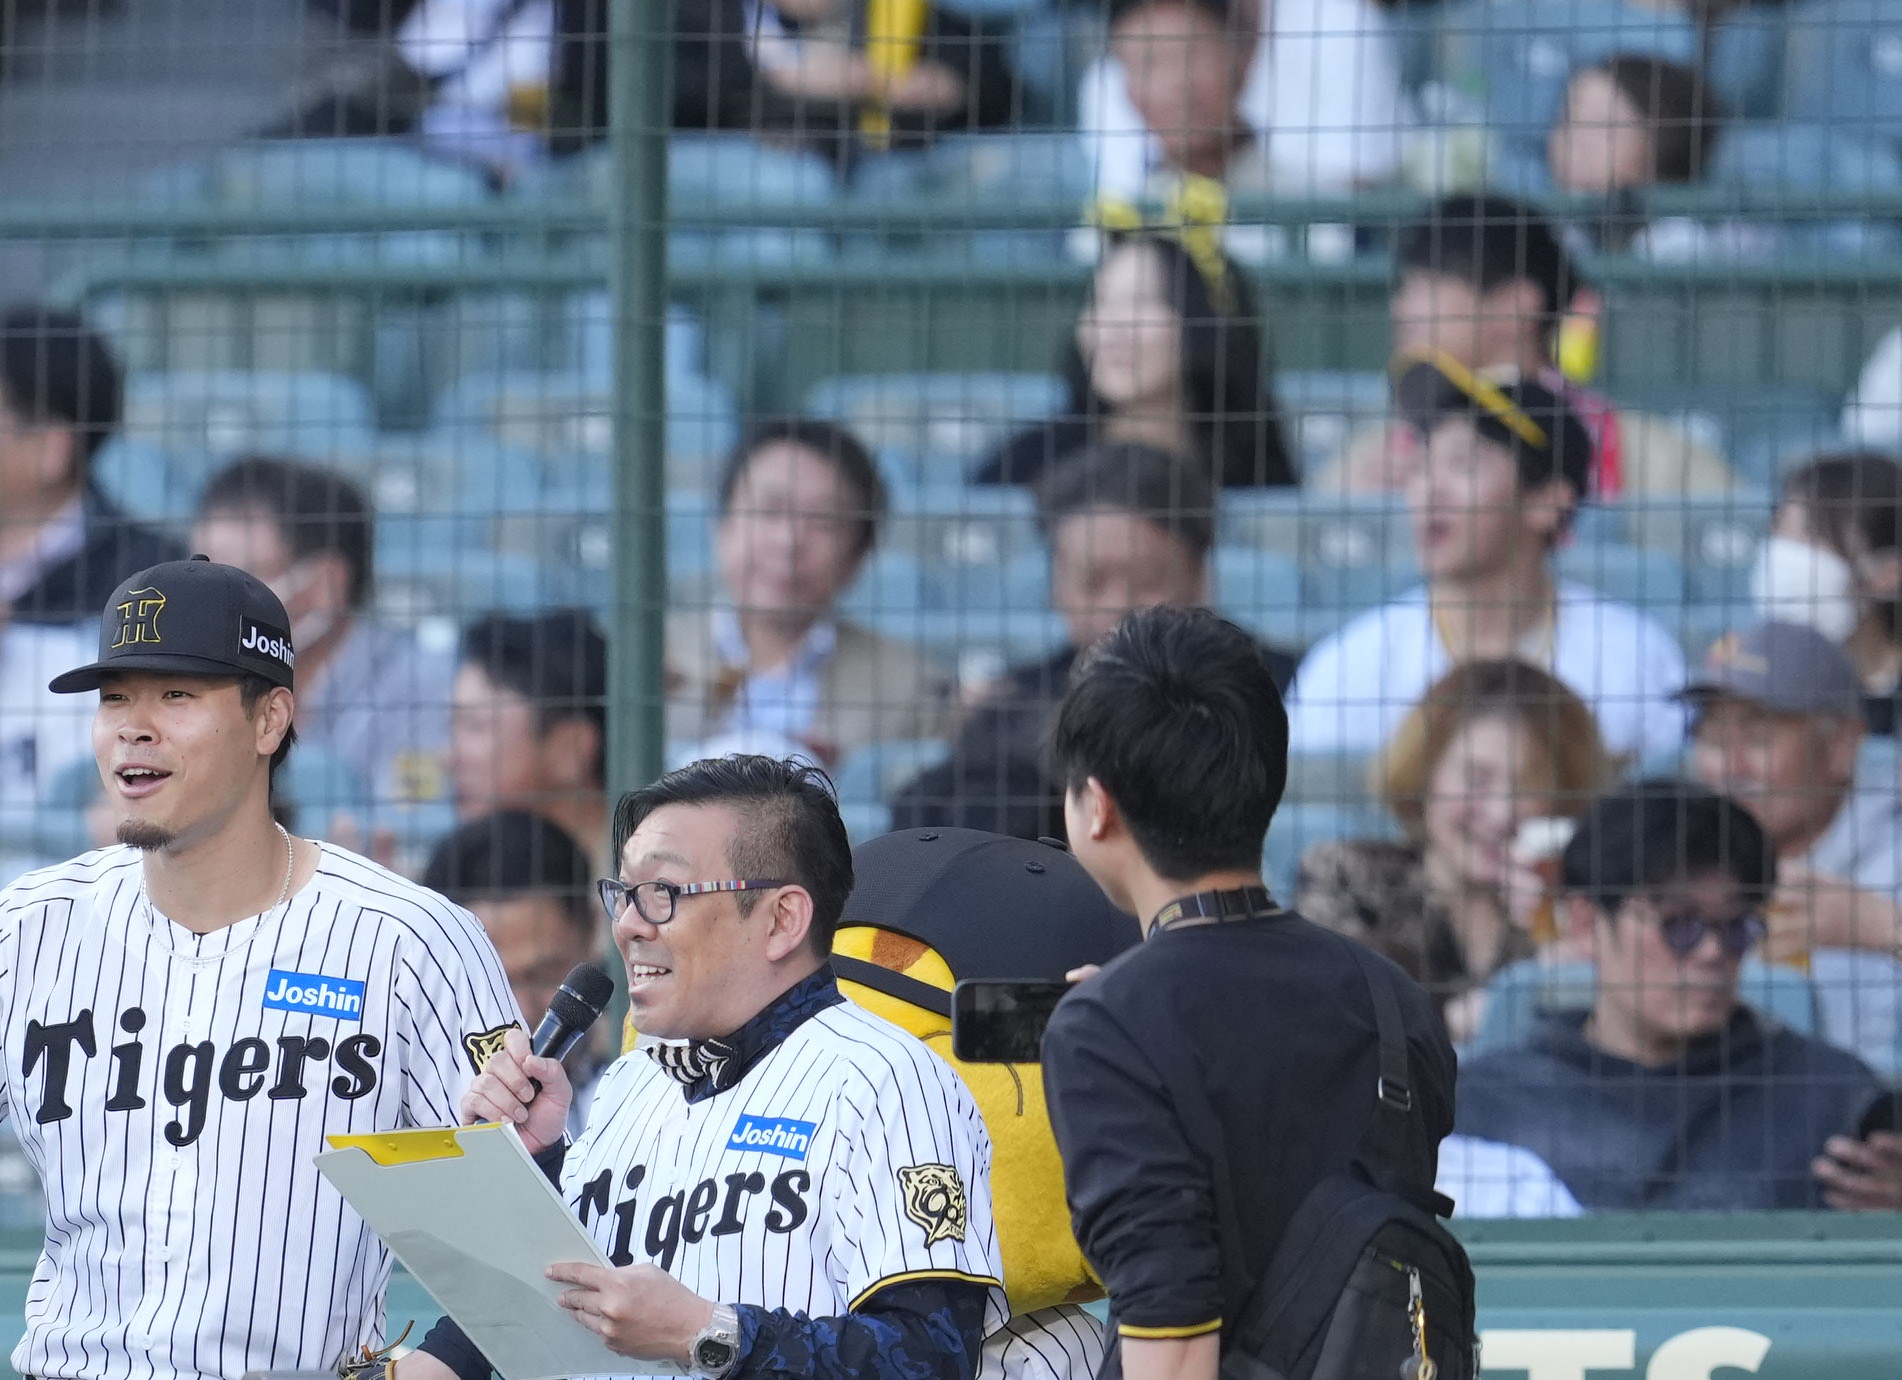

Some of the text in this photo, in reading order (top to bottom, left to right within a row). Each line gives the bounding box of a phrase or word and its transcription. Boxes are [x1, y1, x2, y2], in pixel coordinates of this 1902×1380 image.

[266, 978, 361, 1013] Joshin
[22, 1006, 381, 1147] Tigers
[731, 1122, 809, 1152] Joshin
